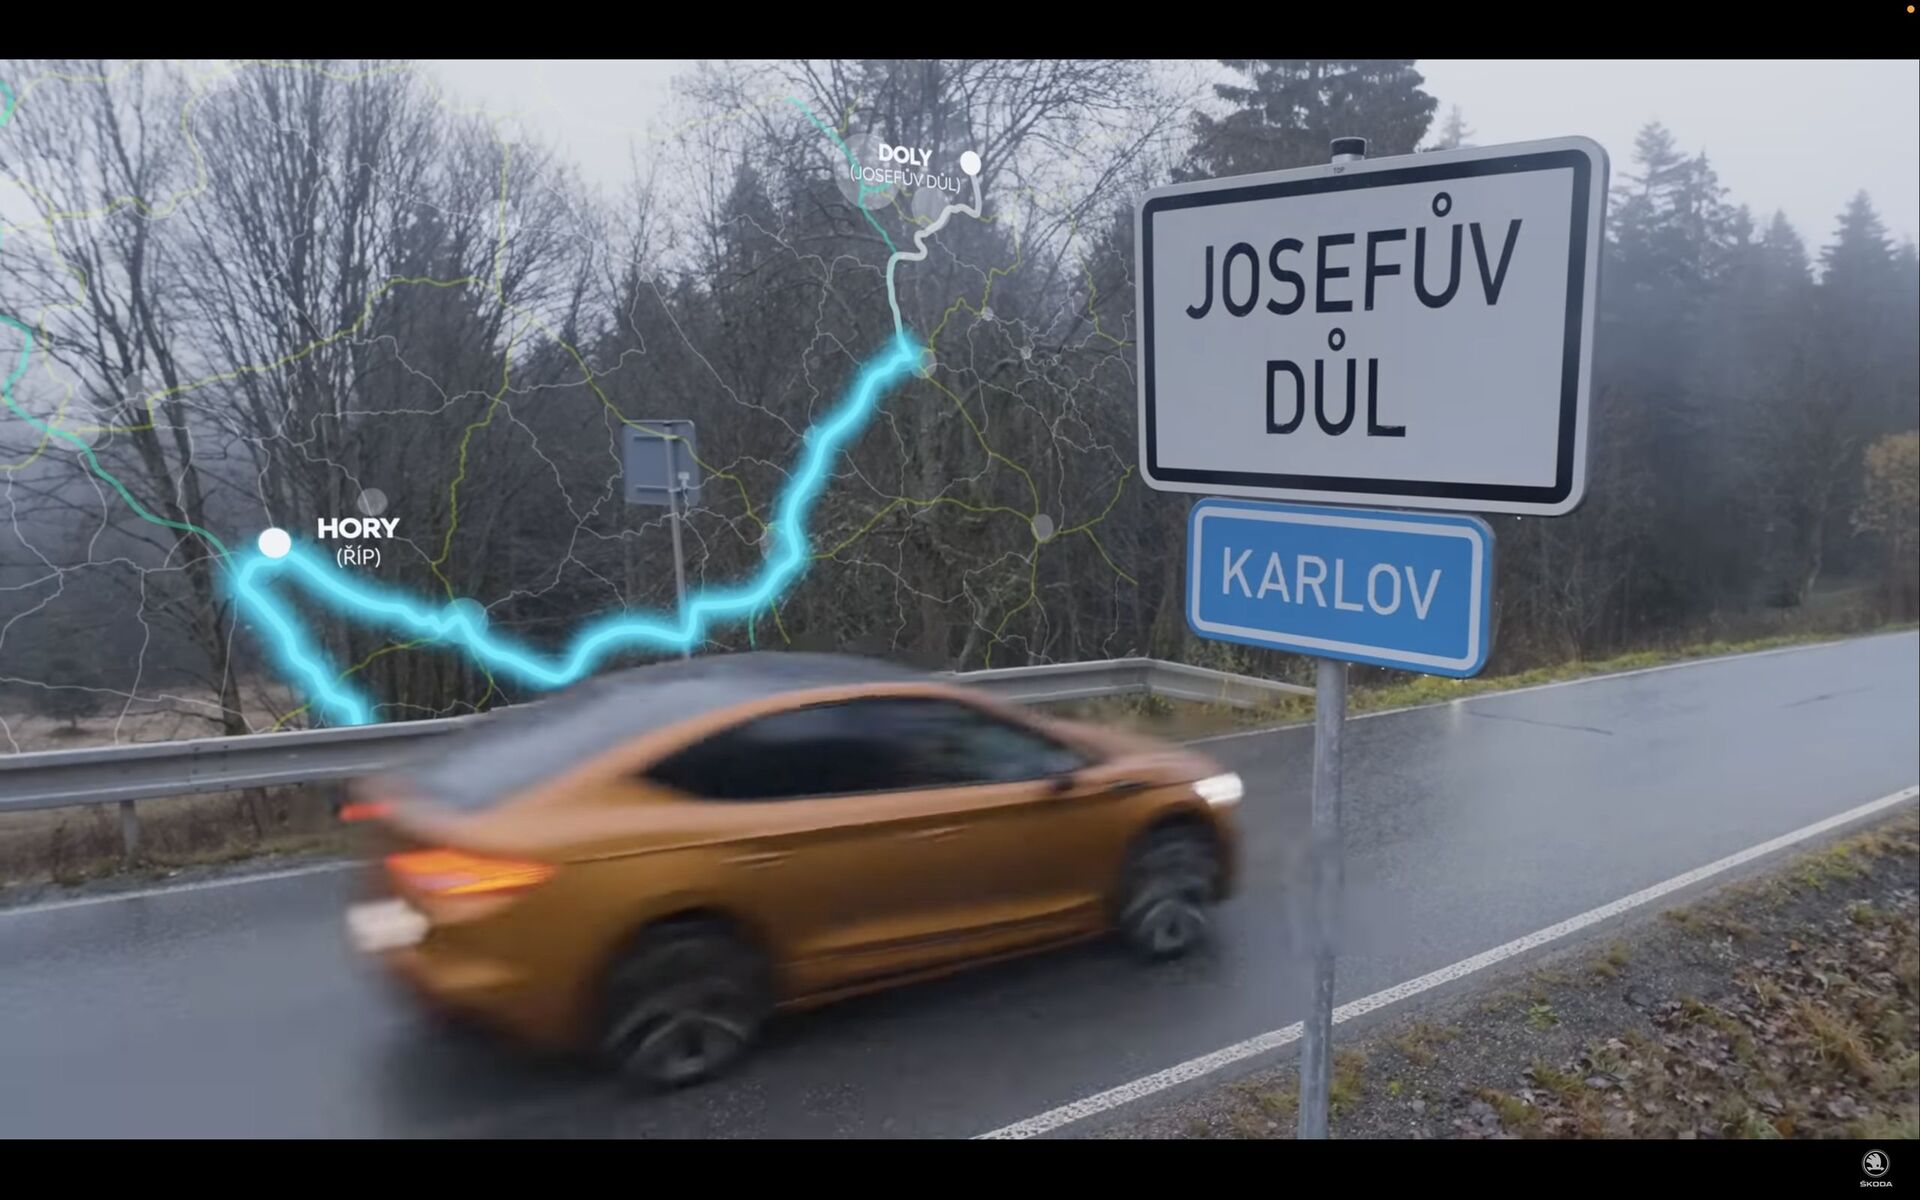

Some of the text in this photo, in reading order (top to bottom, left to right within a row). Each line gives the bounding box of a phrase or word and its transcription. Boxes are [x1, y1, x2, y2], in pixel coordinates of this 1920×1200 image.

[1185, 191, 1523, 320] JOSEFŮV
[1266, 327, 1406, 437] DŮL
[1222, 546, 1442, 620] KARLOV
